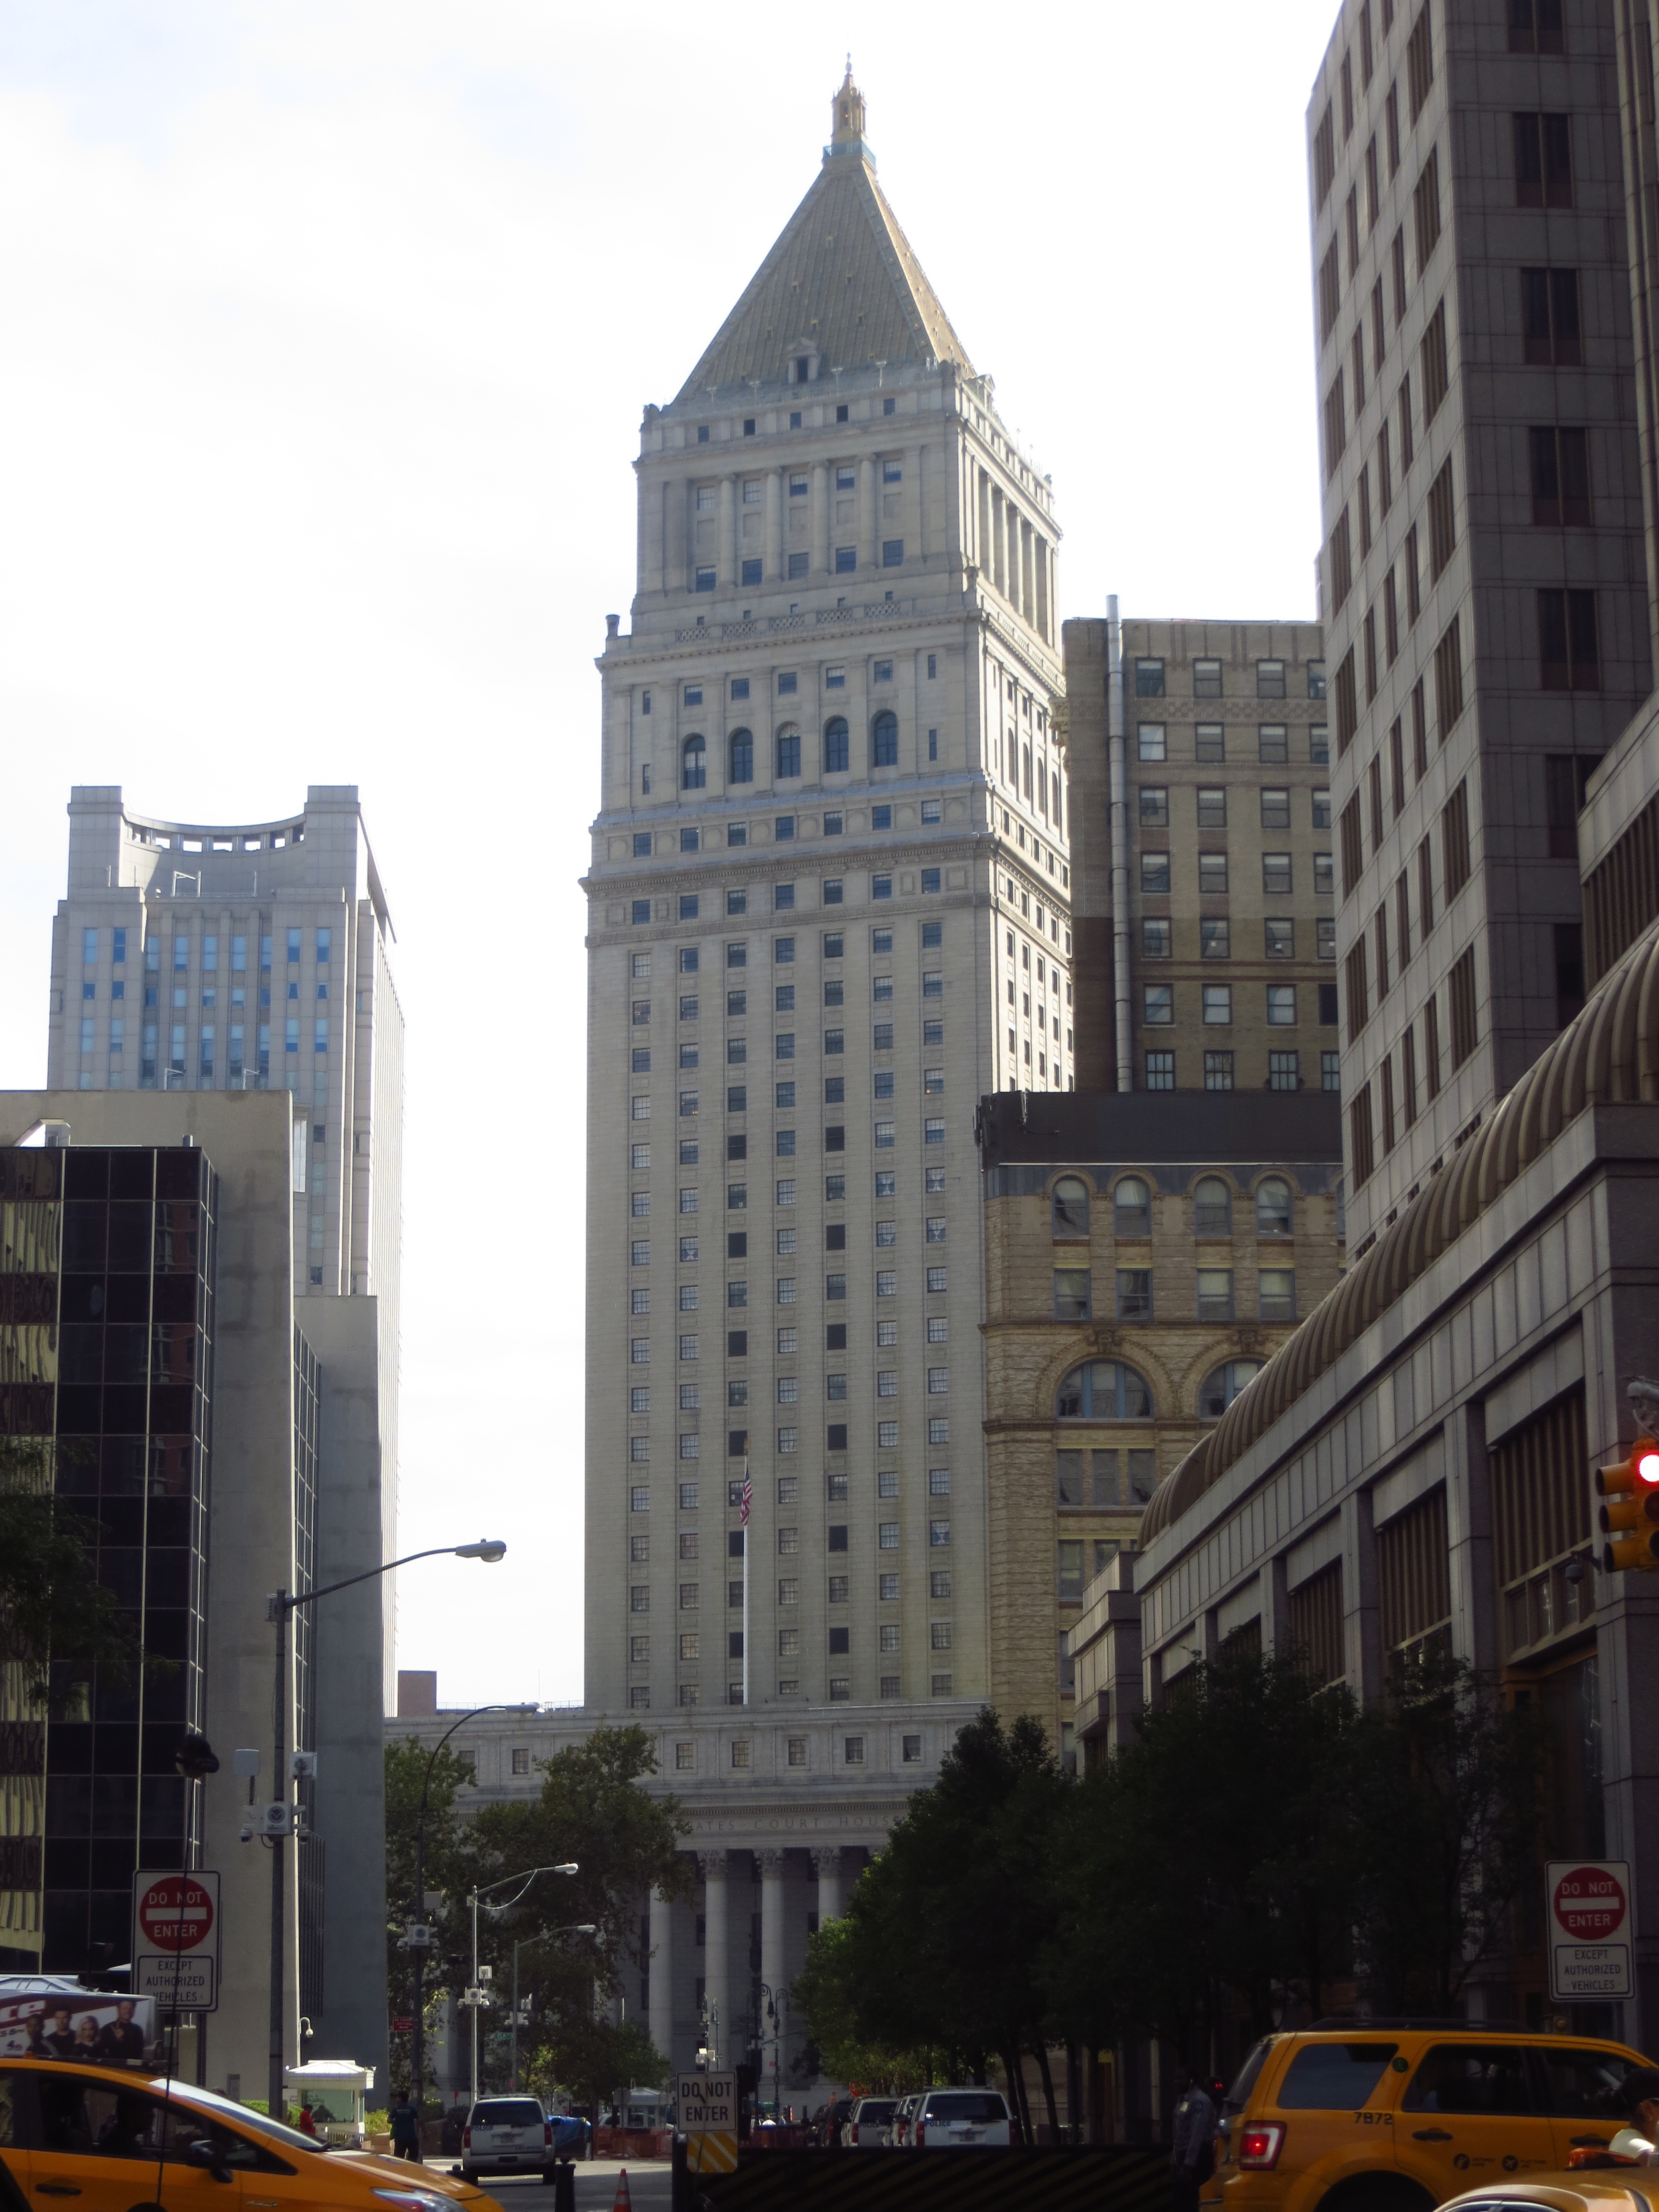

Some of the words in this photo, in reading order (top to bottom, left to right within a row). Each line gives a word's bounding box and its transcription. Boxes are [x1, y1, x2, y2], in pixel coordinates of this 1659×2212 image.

[695, 1820, 735, 1832] ATES
[754, 1818, 821, 1830] COURT
[839, 1816, 889, 1828] HOUS
[1561, 1882, 1579, 1895] DO
[1589, 1881, 1614, 1893] NOT
[149, 1892, 167, 1905] DO
[177, 1891, 202, 1903] NOT
[1568, 1914, 1611, 1927] ENTER
[154, 1925, 197, 1937] ENTER
[1574, 1950, 1608, 1960] EXCEPT
[158, 1960, 192, 1970] EXCEPT
[1564, 1964, 1621, 1975] AUTHORIZED
[146, 1976, 204, 1986] AUTHORIZED
[1571, 1980, 1615, 1990] VEHICLES
[153, 1992, 197, 2002] VEHICLES
[682, 2082, 701, 2098] DO
[705, 2082, 732, 2097] NOT
[685, 2106, 729, 2122] ENTER
[1352, 2111, 1394, 2124] 7872
